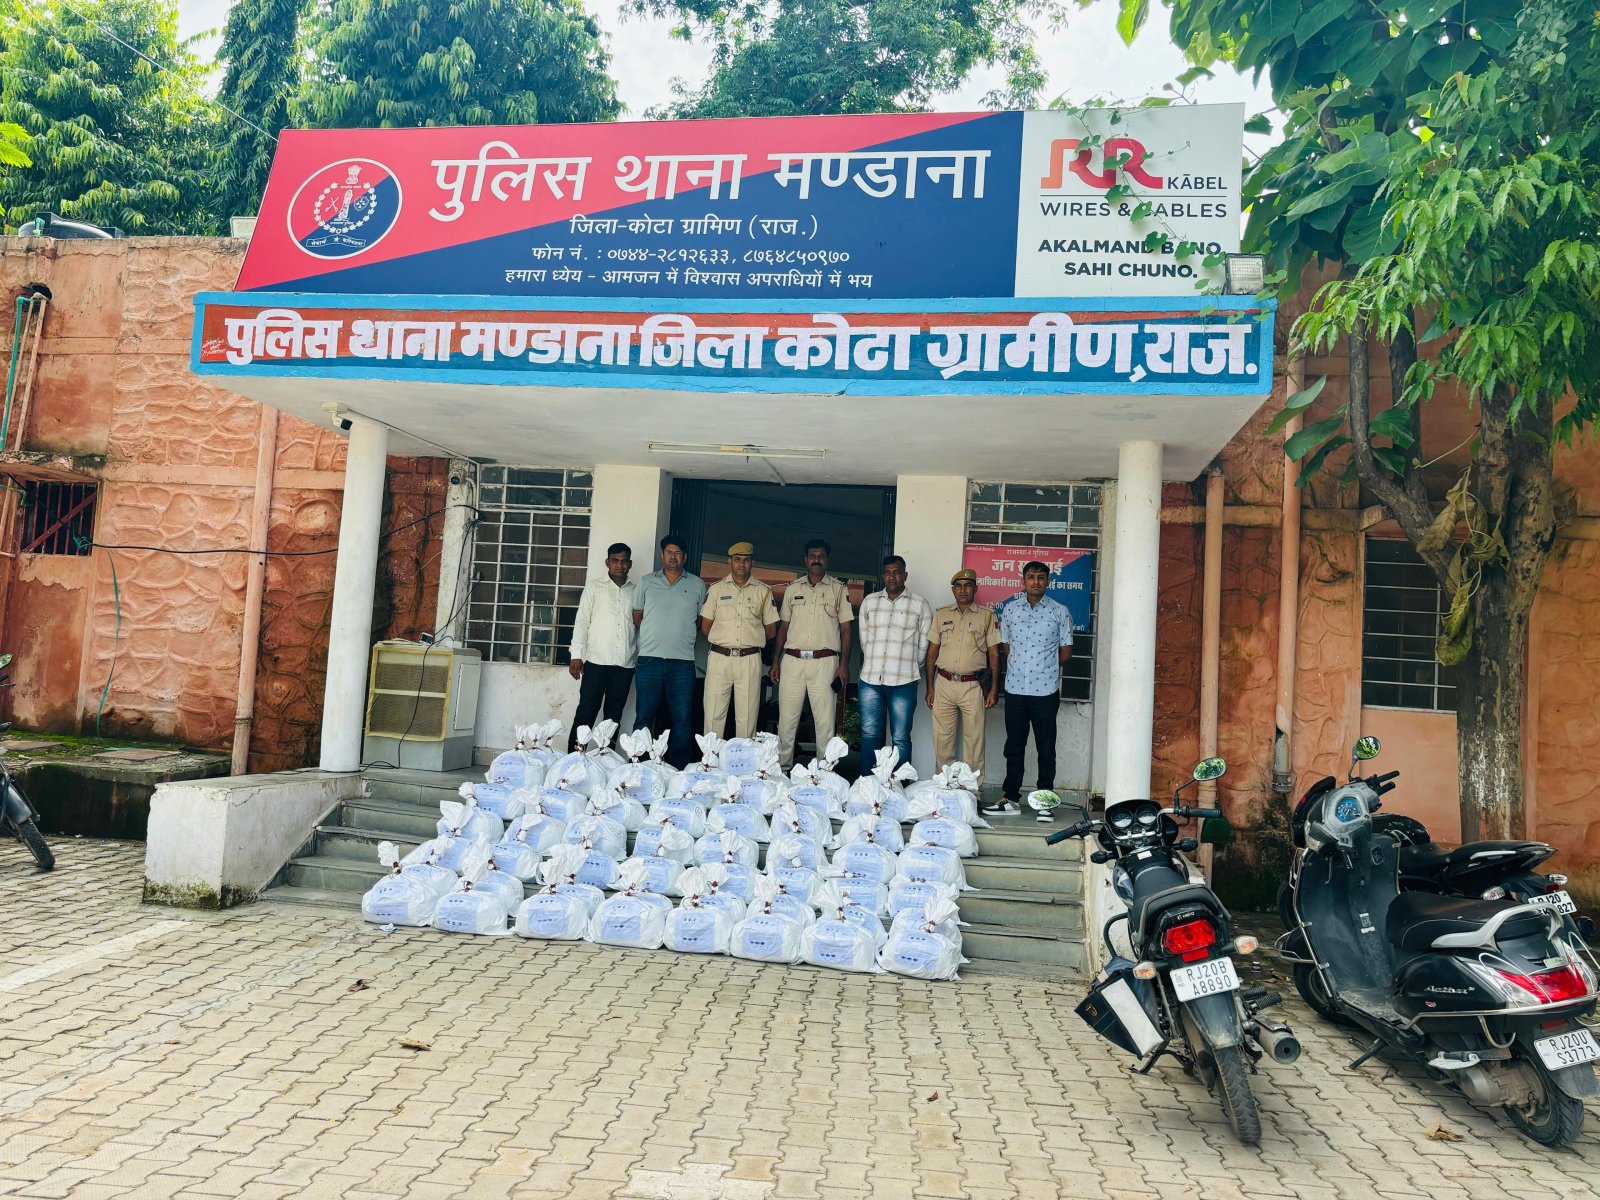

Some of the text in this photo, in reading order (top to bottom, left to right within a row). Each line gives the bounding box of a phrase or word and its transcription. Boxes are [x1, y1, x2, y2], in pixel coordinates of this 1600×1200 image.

[428, 140, 991, 222] पुलिस थाना मण्डाना
[1040, 202, 1227, 218] WIRES & ABLES
[569, 213, 674, 235] जिला-कोटा
[680, 213, 742, 235] ग्रामिण
[532, 243, 564, 260] फोन
[1161, 241, 1222, 256] BNO
[505, 269, 547, 283] हमारा
[552, 266, 583, 283] ध्येय
[602, 270, 660, 284] आमजन
[665, 267, 679, 284] में
[684, 267, 742, 286] विश्वास
[746, 269, 823, 287] अपराधियों
[828, 269, 843, 288] में
[848, 273, 873, 289] भय
[1064, 262, 1198, 278] SAHI CHUNO.
[225, 309, 343, 366] पुलिस
[349, 319, 455, 361] थाना
[460, 322, 636, 365] मण्डाना
[638, 314, 768, 369] जिला
[775, 314, 920, 371] कोटा
[991, 559, 1015, 572] जन
[986, 602, 1004, 610] 12:00
[1186, 960, 1227, 982] RJ20B
[1193, 974, 1232, 996] A8890
[1548, 1032, 1588, 1052] RJ20U
[1556, 1045, 1596, 1065] S3773
